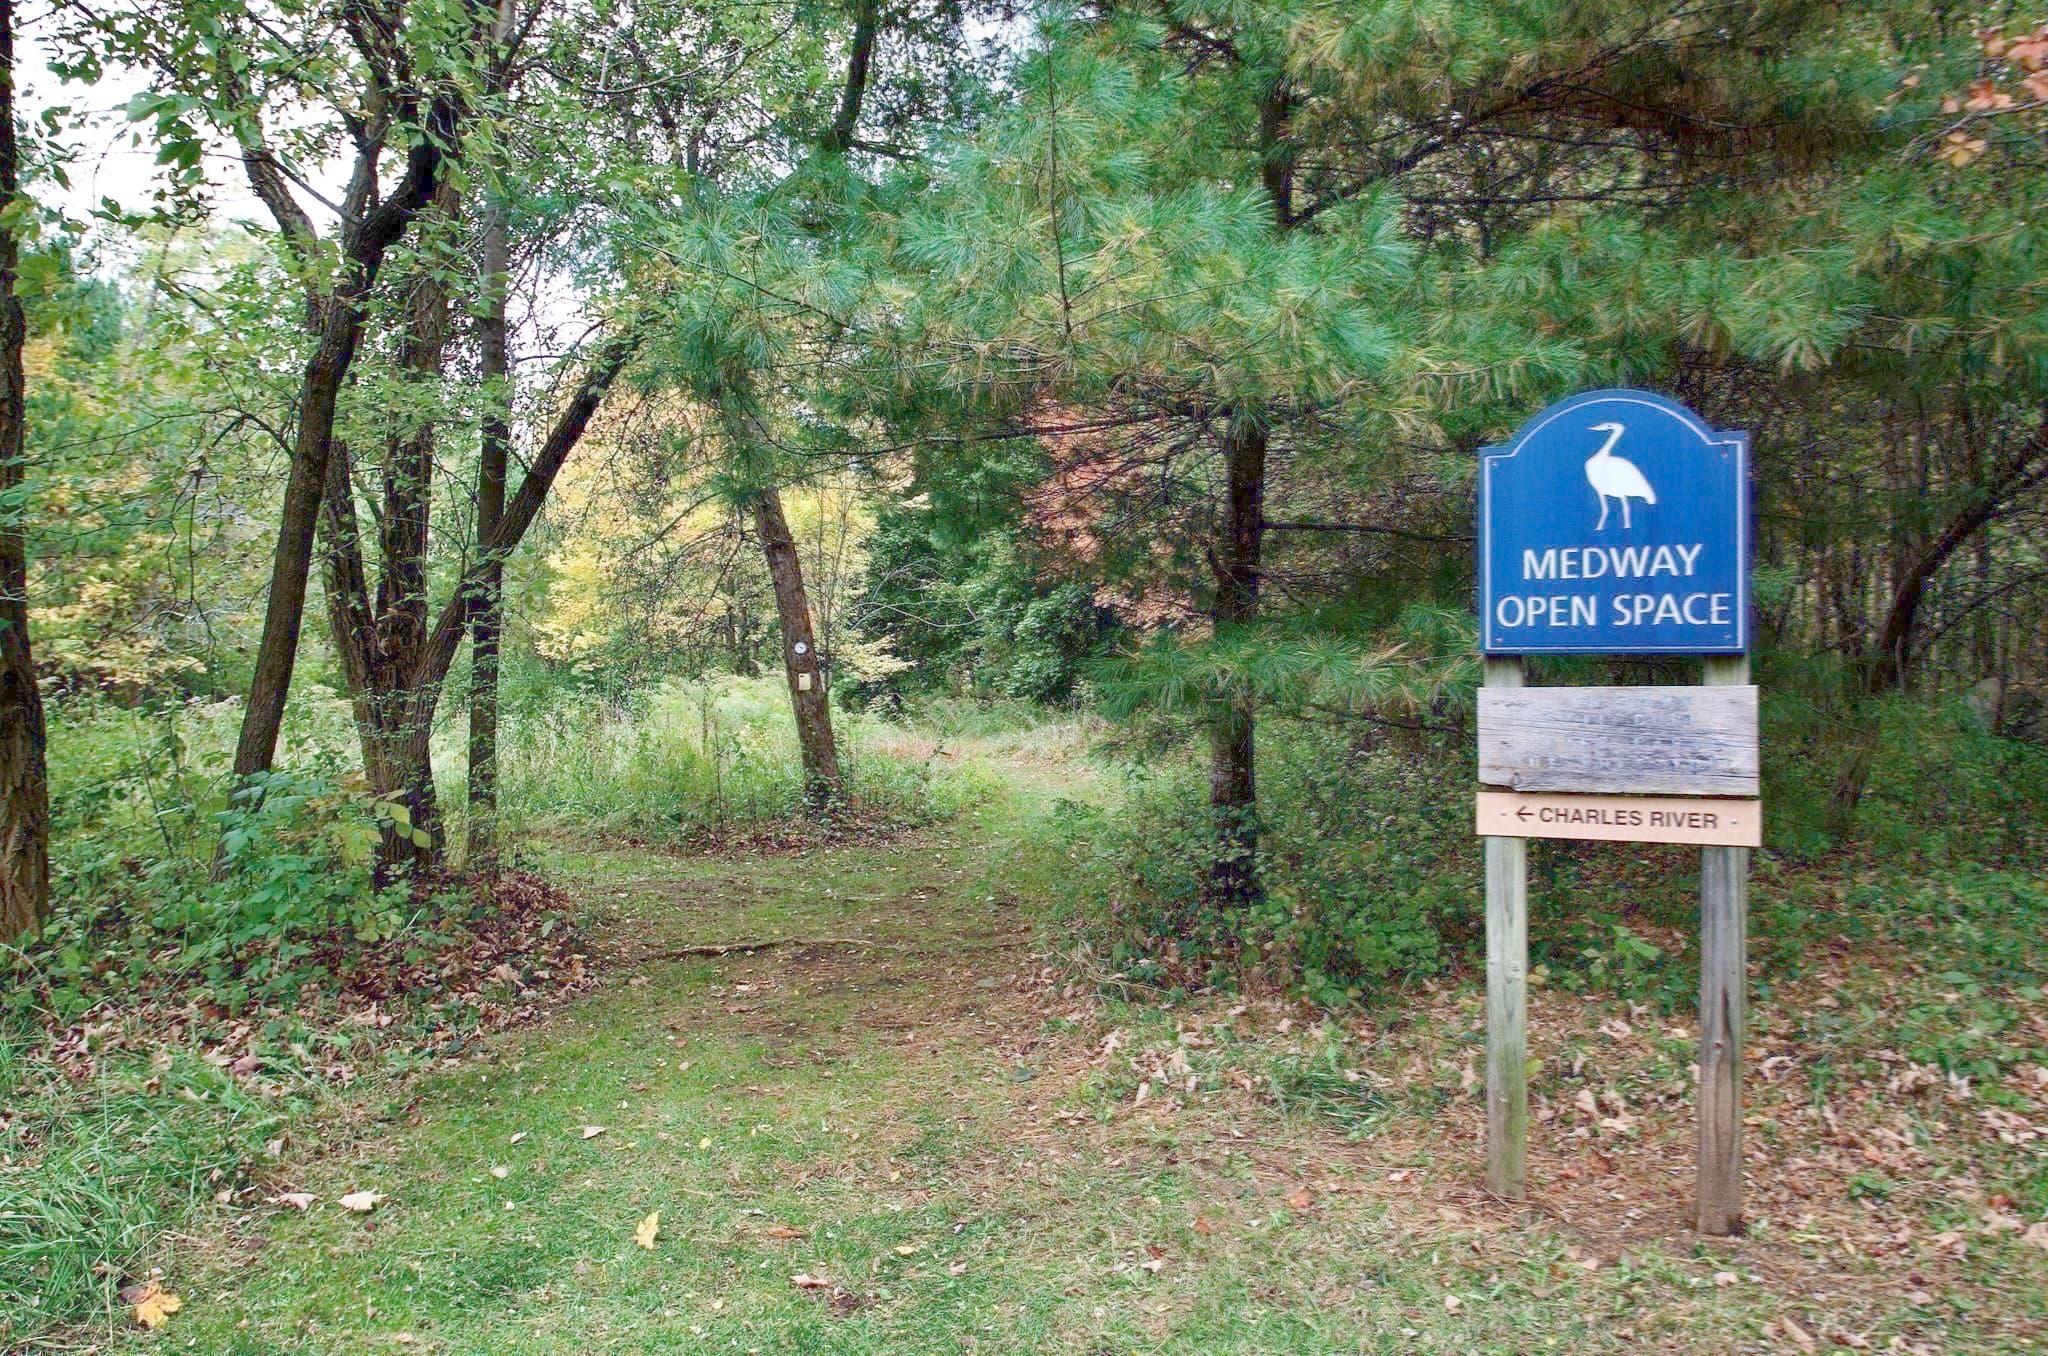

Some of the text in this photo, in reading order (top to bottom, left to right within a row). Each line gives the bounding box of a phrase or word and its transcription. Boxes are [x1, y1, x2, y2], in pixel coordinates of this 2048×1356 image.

[1522, 543, 1703, 581] MEDWAY
[1496, 592, 1732, 628] OPEN SPACE
[1538, 806, 1719, 830] CHARLES RIVER
